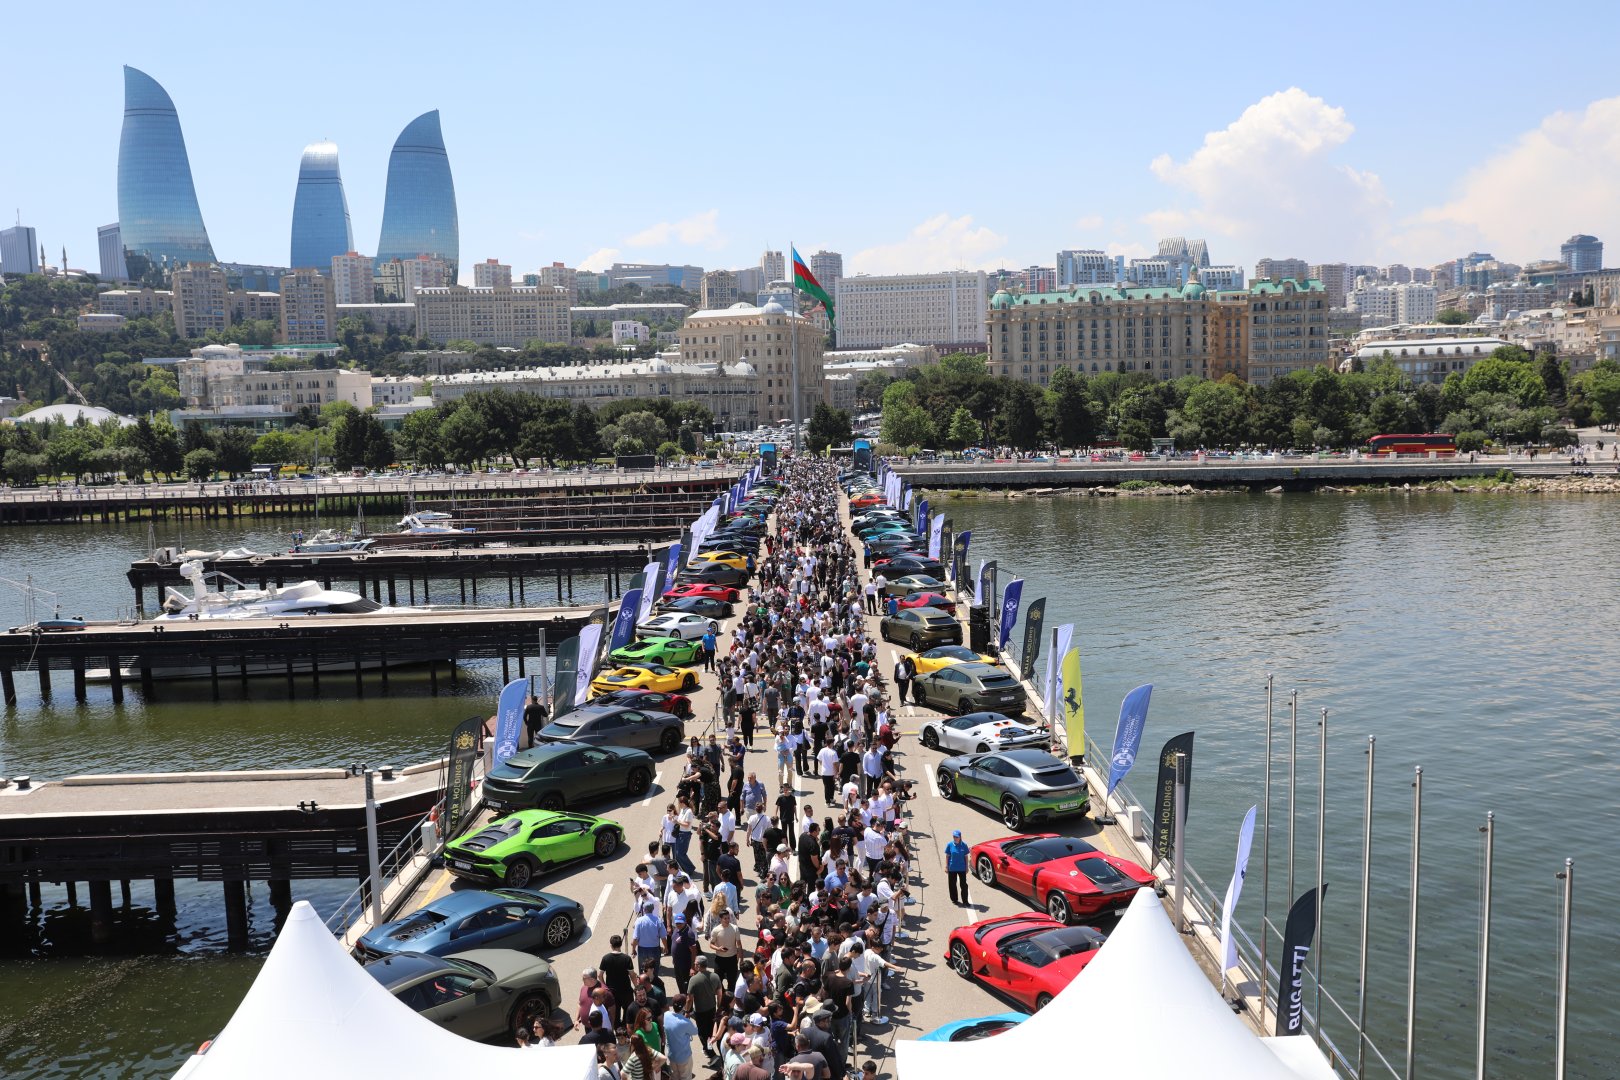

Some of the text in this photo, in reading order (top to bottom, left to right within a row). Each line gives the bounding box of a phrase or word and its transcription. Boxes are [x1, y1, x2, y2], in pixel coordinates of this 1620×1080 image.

[454, 759, 463, 799] HOLDINGS
[1162, 779, 1173, 824] HOLDINGS
[1288, 945, 1310, 1030] BUGATTI
